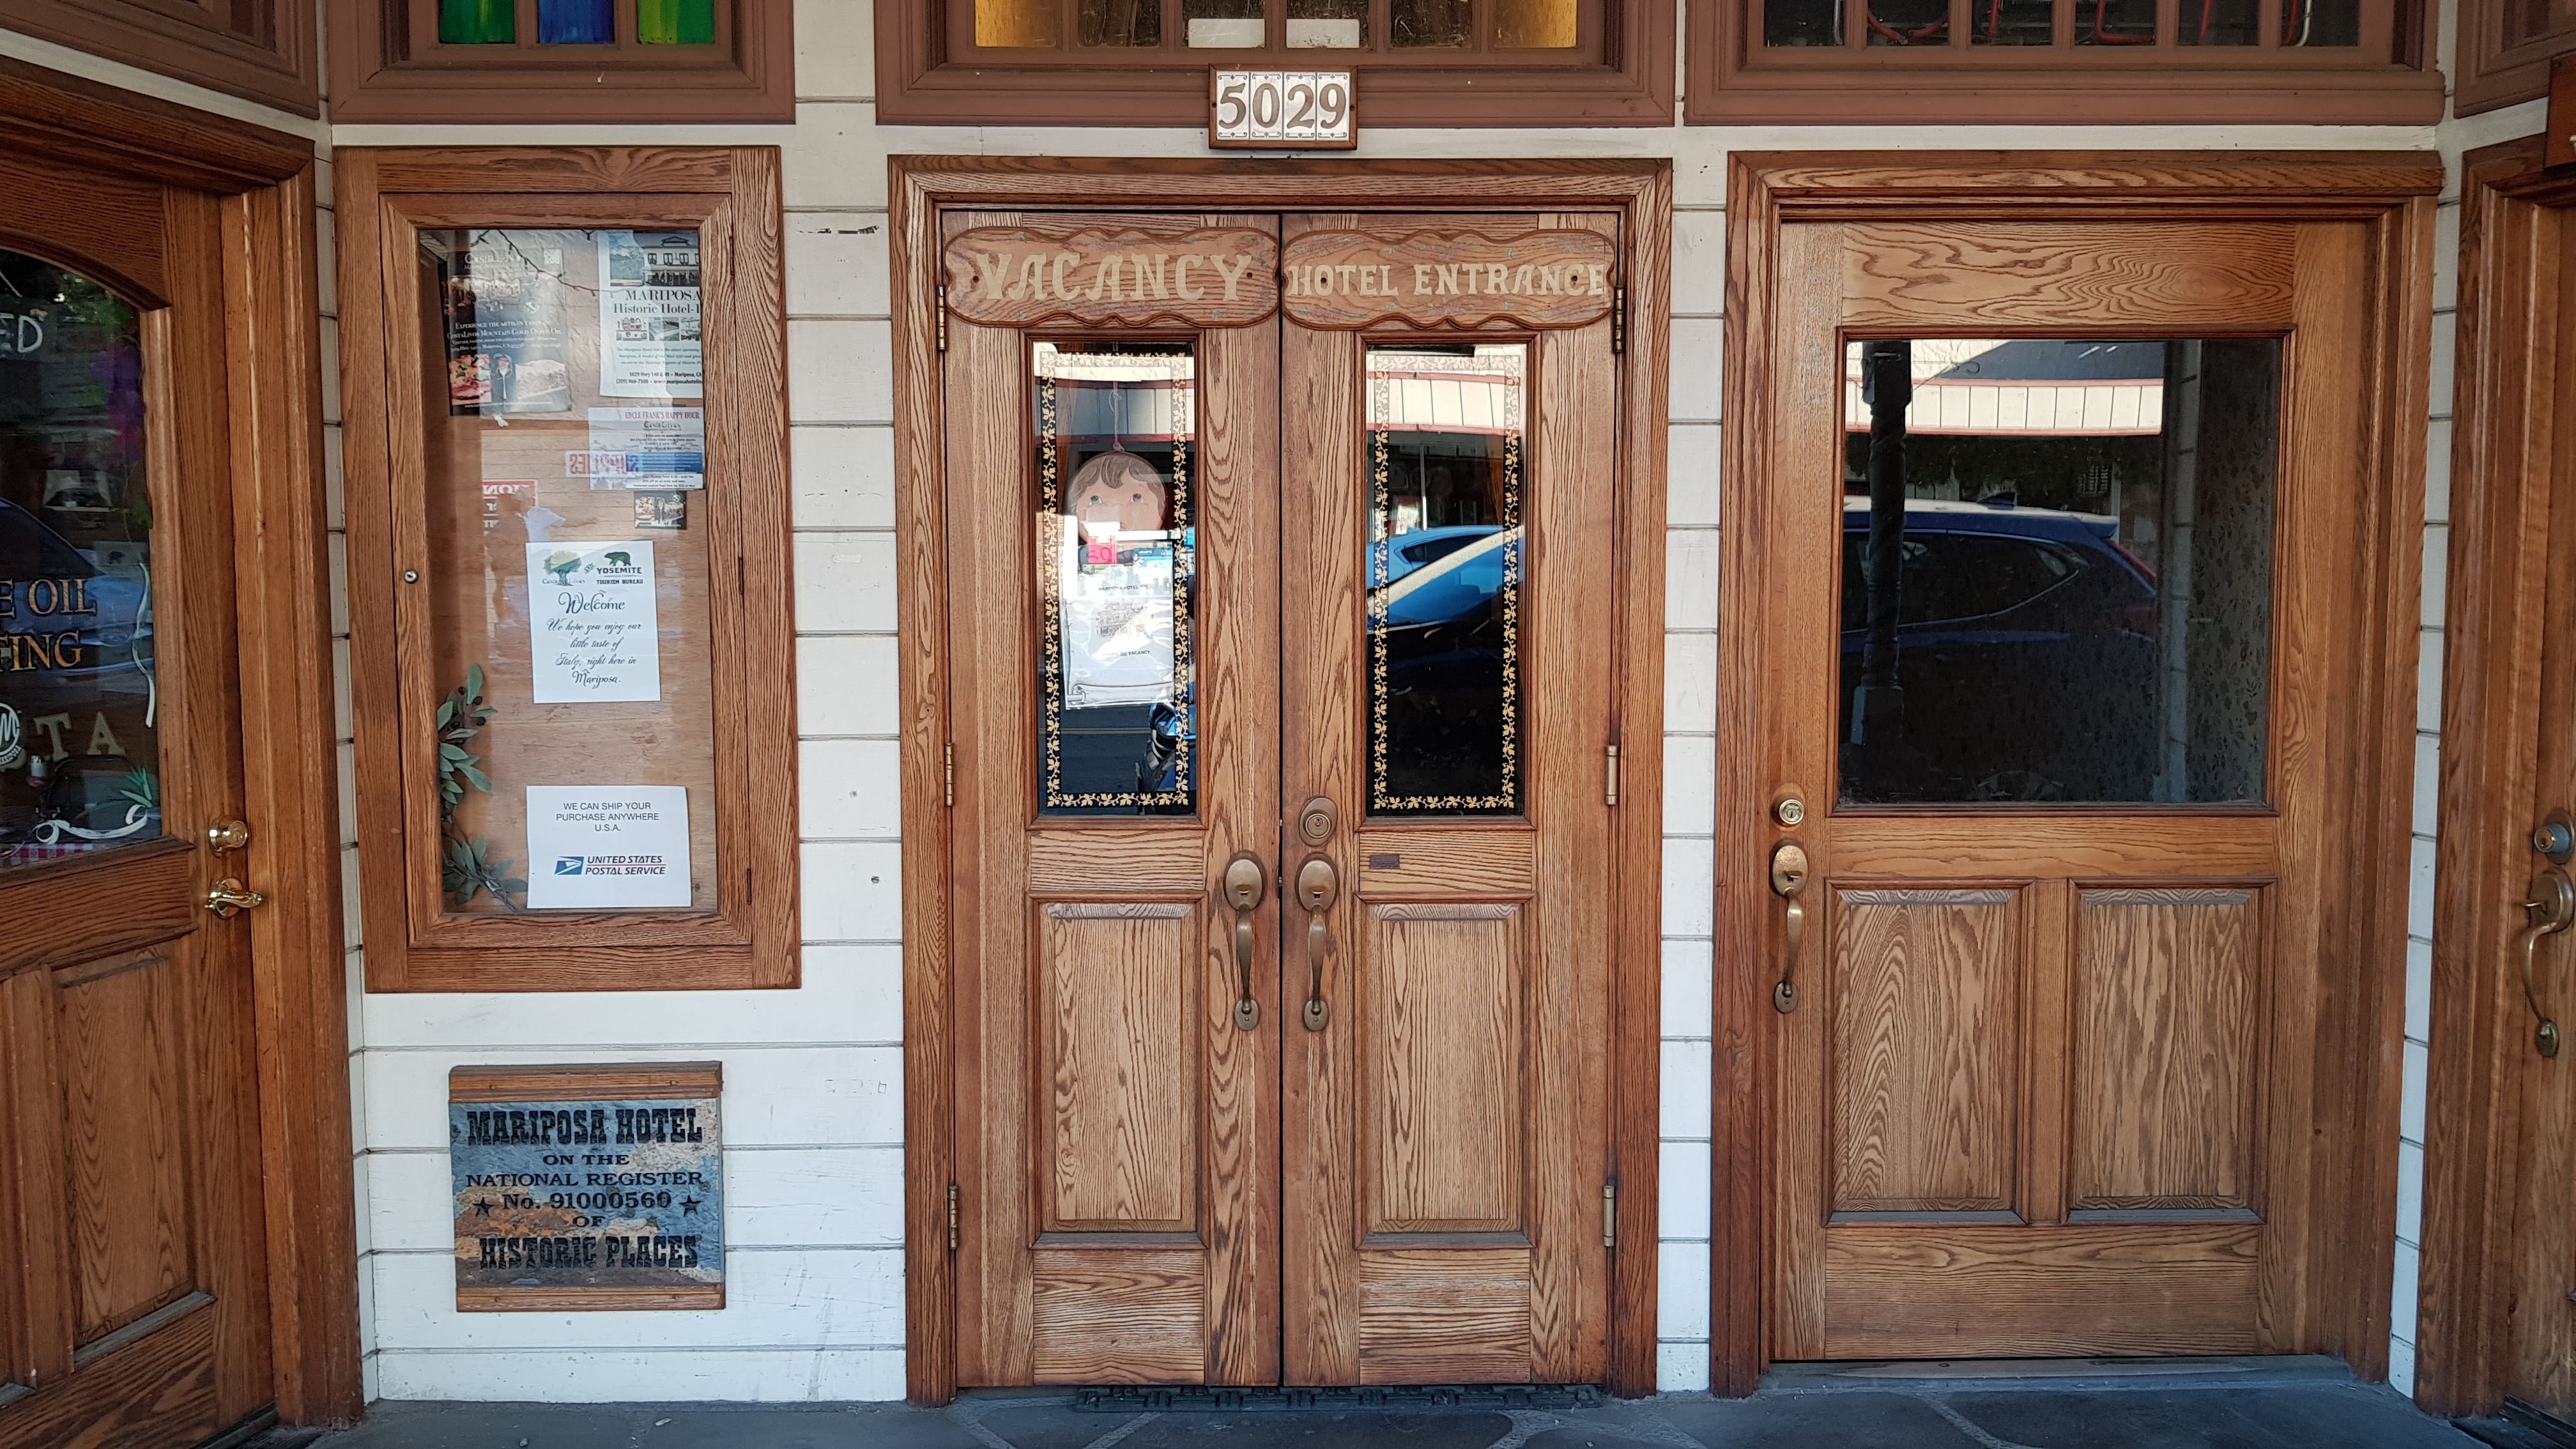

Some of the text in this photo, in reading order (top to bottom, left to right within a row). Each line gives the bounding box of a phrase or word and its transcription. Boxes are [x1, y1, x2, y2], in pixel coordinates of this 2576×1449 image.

[1218, 82, 1347, 129] 5029
[975, 252, 1252, 302] VACANCY
[1287, 262, 1609, 297] HOTEL ENTRANCE
[614, 303, 657, 314] Historic
[29, 578, 96, 614] OIL
[558, 589, 625, 614] Welcome
[546, 618, 563, 631] We
[565, 619, 583, 635] hope
[585, 624, 601, 634] you
[604, 622, 624, 634] enjoy
[570, 636, 624, 652] little taste of
[587, 654, 606, 670] right
[608, 654, 625, 664] here
[628, 656, 638, 664] in
[572, 669, 622, 689] Mariposa.
[585, 866, 666, 875] POSTAL SERVICE
[466, 1108, 702, 1146] MARIPOSA HOTEL
[542, 1154, 630, 1165] ON THE
[465, 1172, 703, 1188] NATIONAL REGISTER
[502, 1192, 671, 1210] No. 91000560
[572, 1215, 606, 1228] OF
[479, 1235, 698, 1269] HISTORIC PLACES
